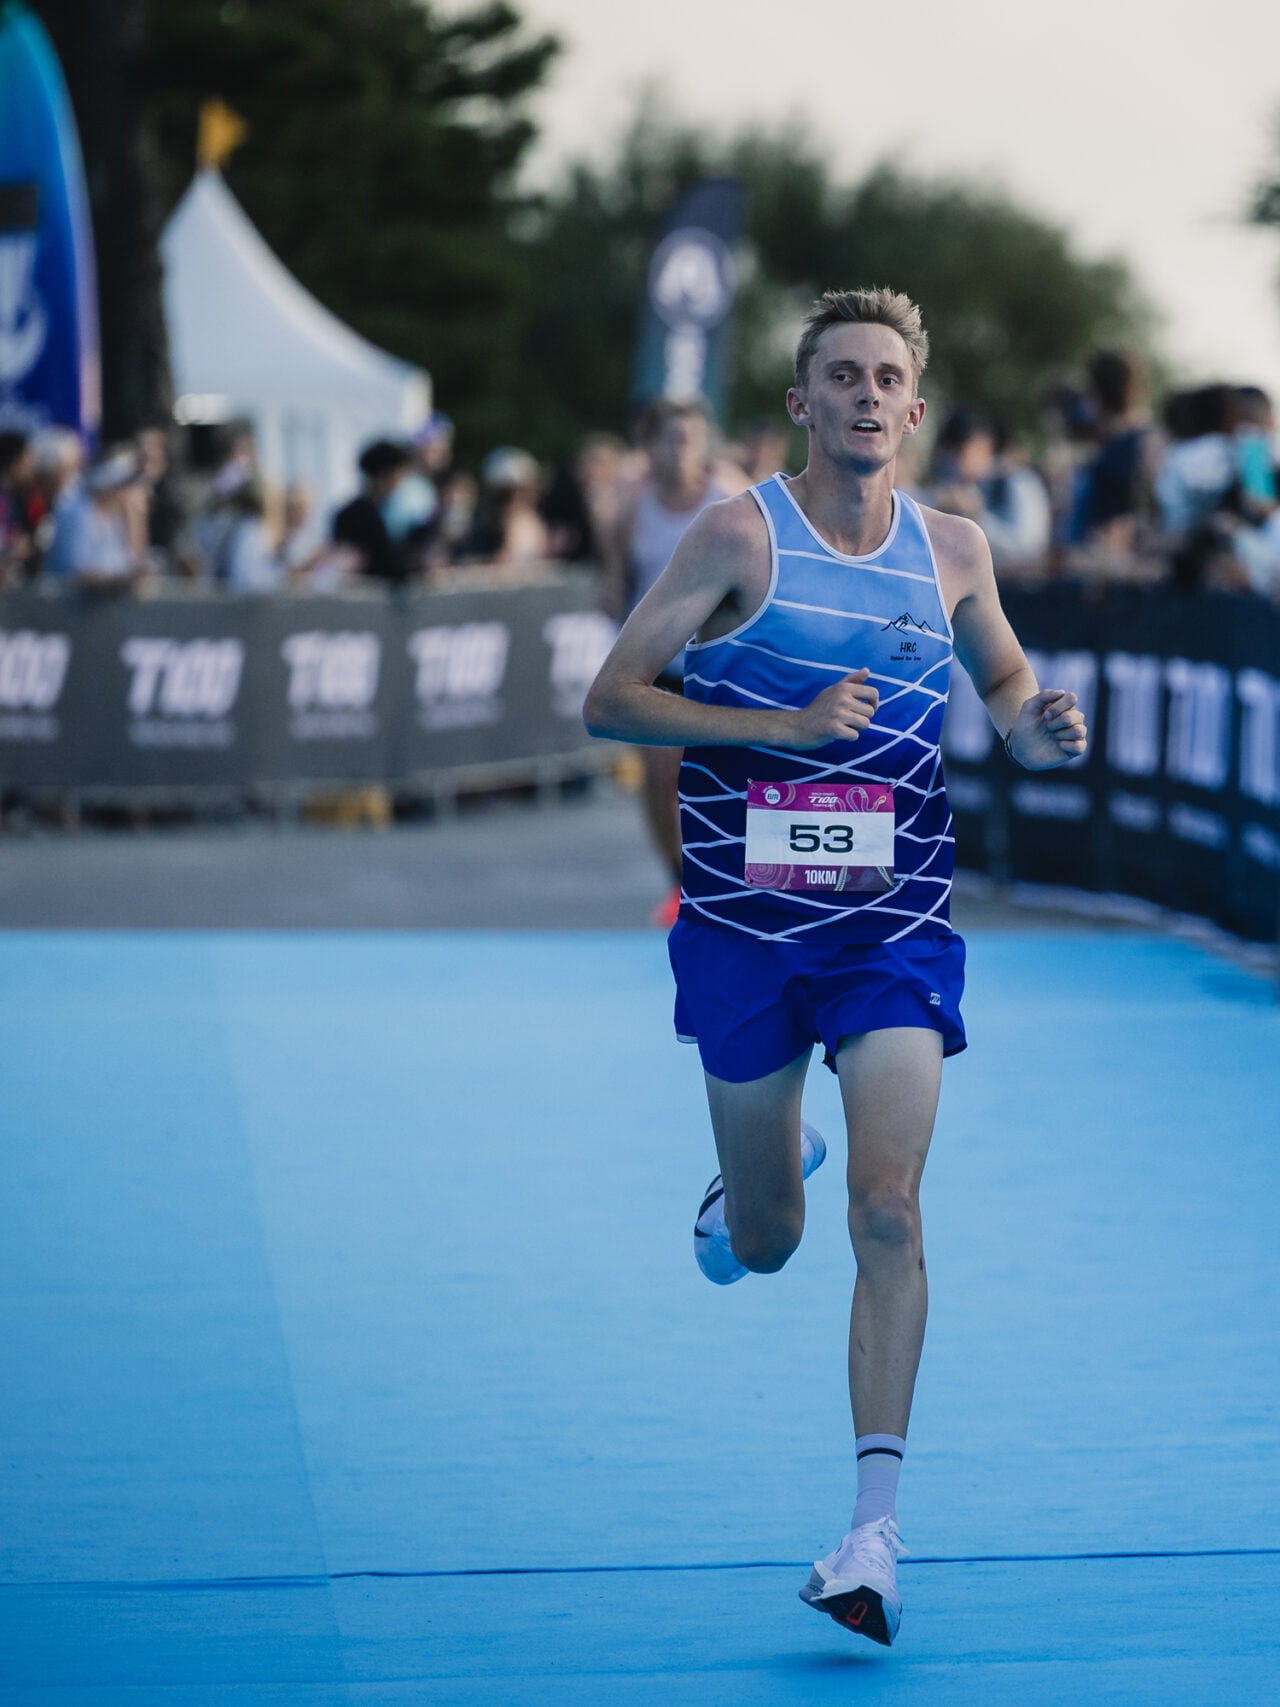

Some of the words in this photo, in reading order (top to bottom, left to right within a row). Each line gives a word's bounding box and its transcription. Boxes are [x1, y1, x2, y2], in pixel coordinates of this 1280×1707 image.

[900, 641, 917, 653] HRC
[808, 796, 838, 804] T100
[789, 824, 854, 853] 53
[805, 870, 837, 885] 10KM
